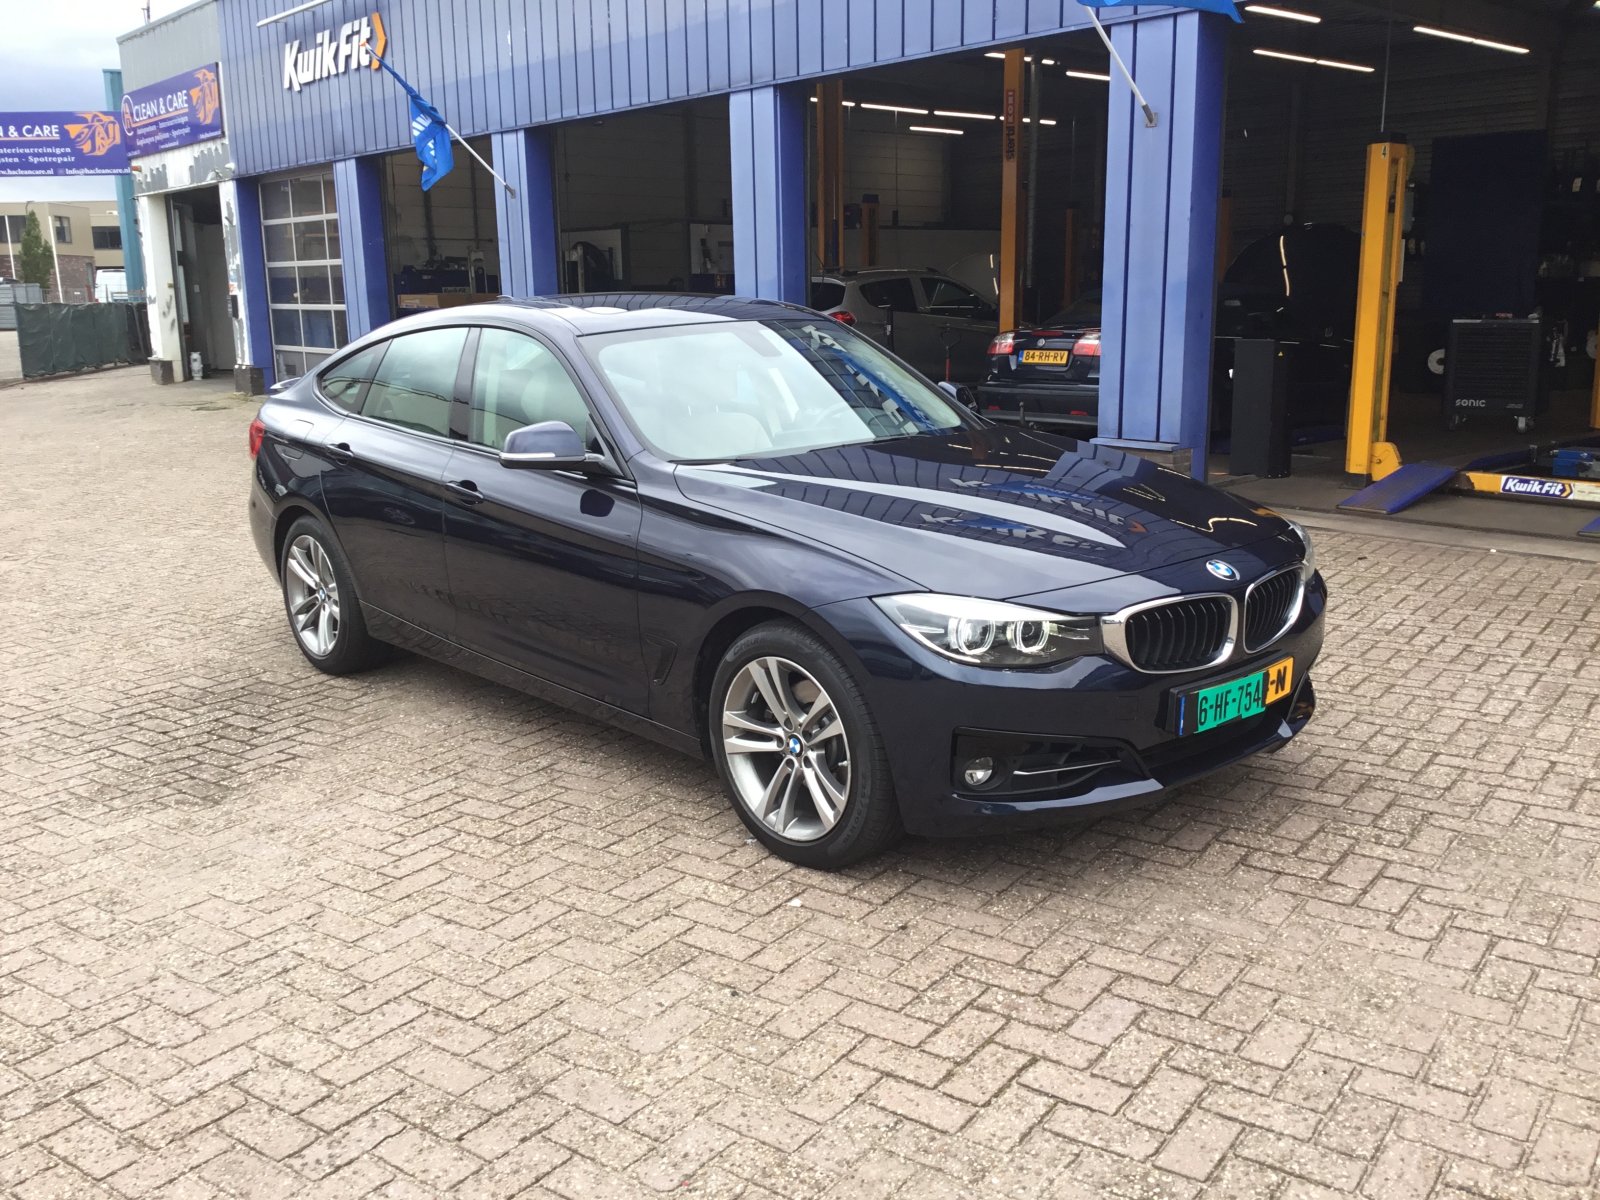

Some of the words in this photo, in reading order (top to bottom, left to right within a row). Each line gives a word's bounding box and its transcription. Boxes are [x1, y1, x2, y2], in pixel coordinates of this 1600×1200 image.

[284, 16, 371, 92] KwikFit
[133, 100, 158, 121] CLEAN
[159, 98, 166, 115] &
[166, 90, 189, 112] CARE
[8, 125, 19, 137] &
[22, 125, 60, 137] CARE
[28, 155, 76, 164] Spotrepair
[1025, 351, 1065, 361] 84-RH-RV
[1505, 478, 1564, 496] KwikFit
[1199, 680, 1262, 726] 6-HF-754
